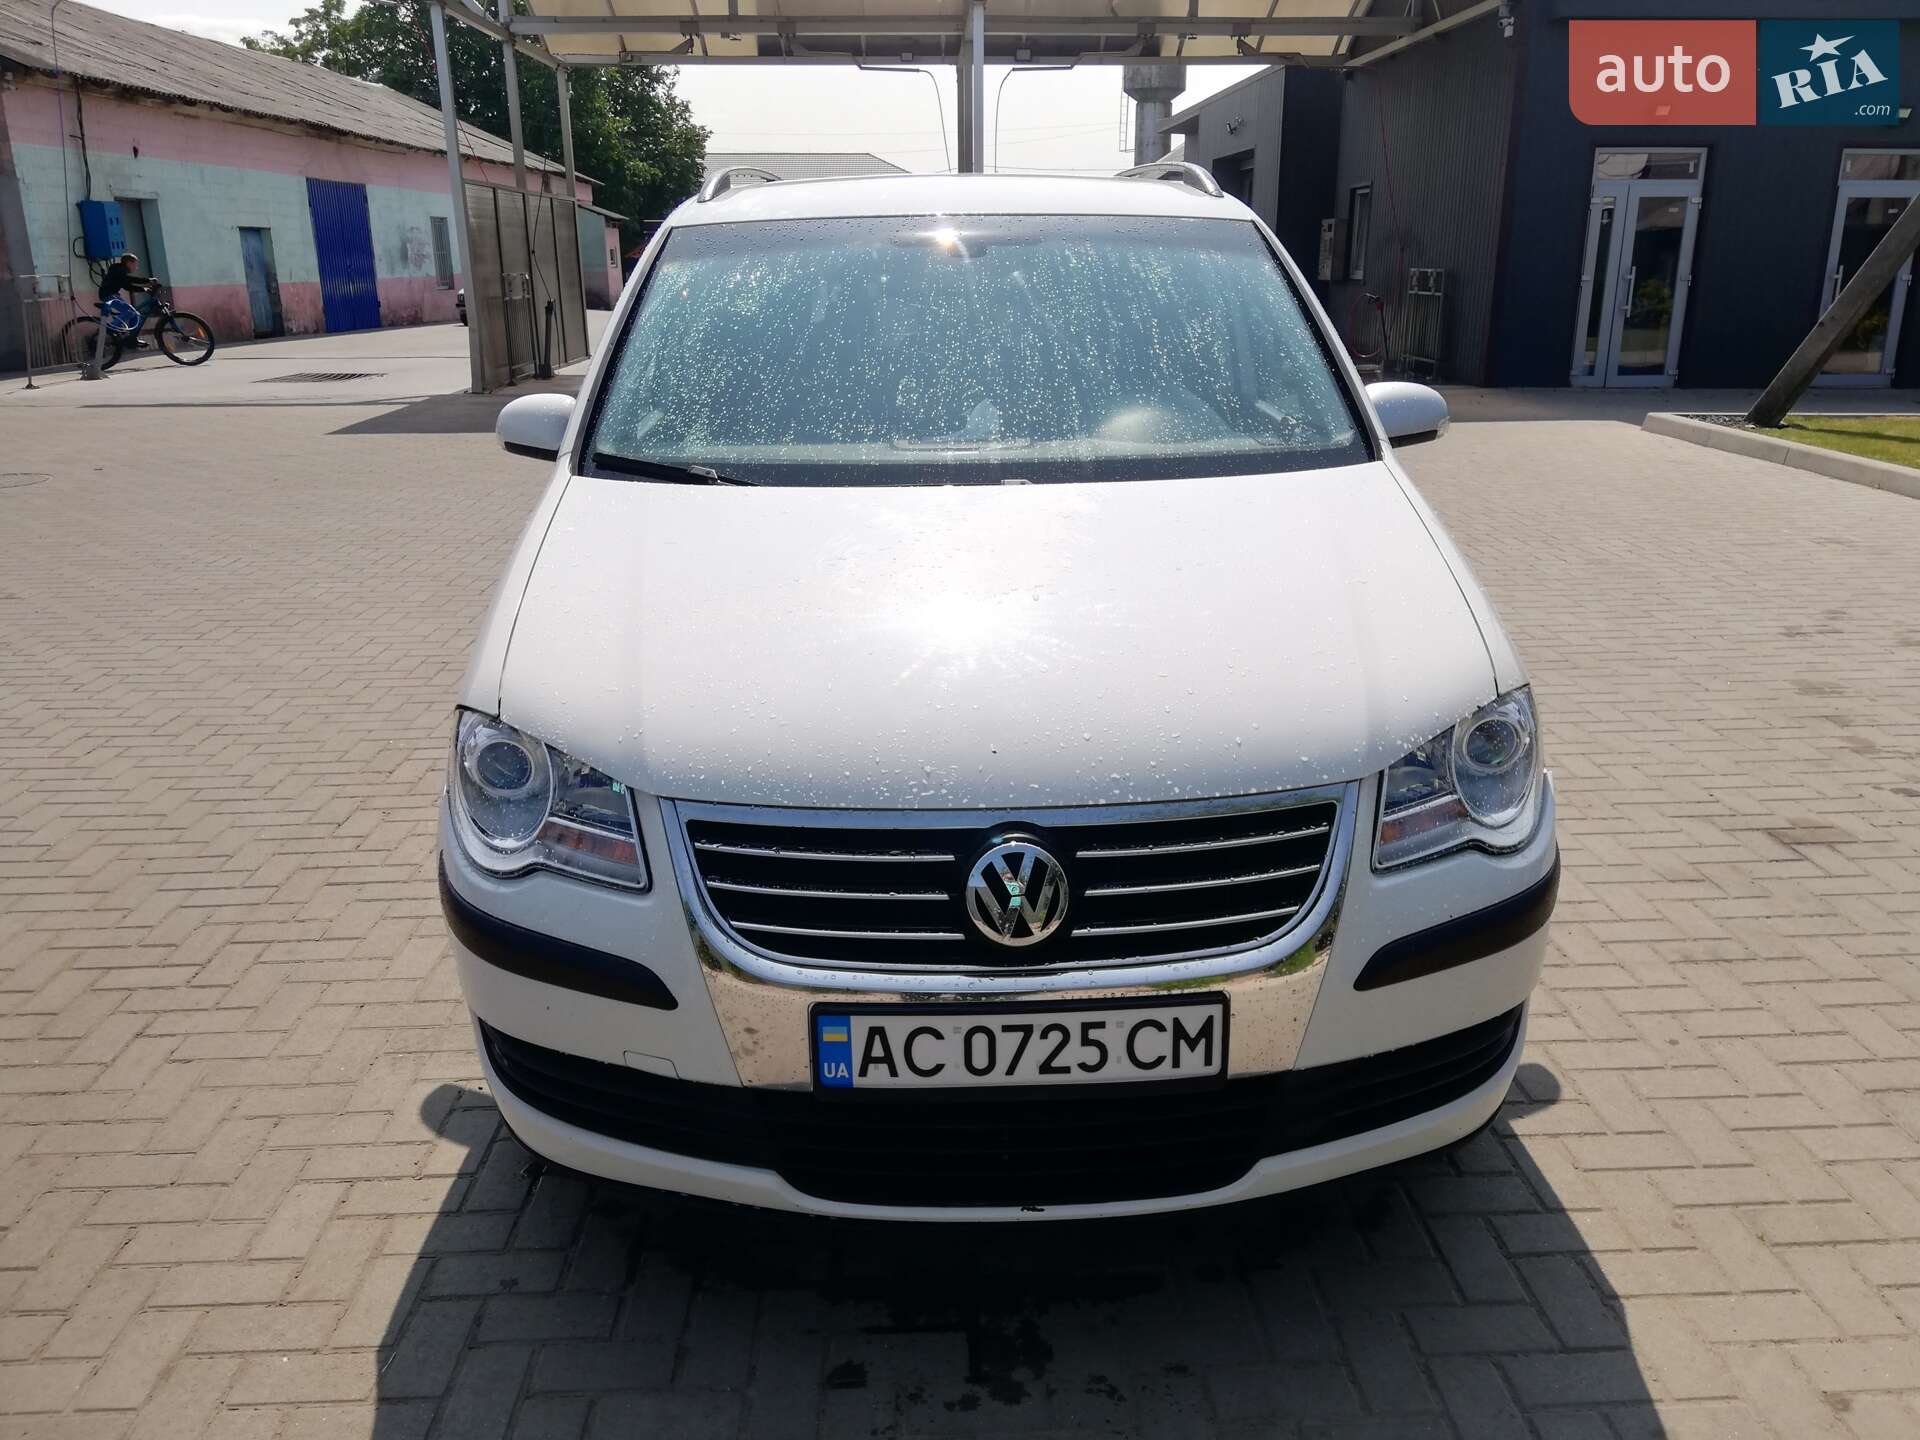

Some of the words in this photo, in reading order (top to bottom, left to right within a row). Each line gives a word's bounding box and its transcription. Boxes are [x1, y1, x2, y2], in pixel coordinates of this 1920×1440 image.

[857, 1026, 945, 1078] AC
[963, 1021, 1109, 1077] 0725
[1125, 1015, 1215, 1070] CM
[823, 1062, 849, 1079] UA
